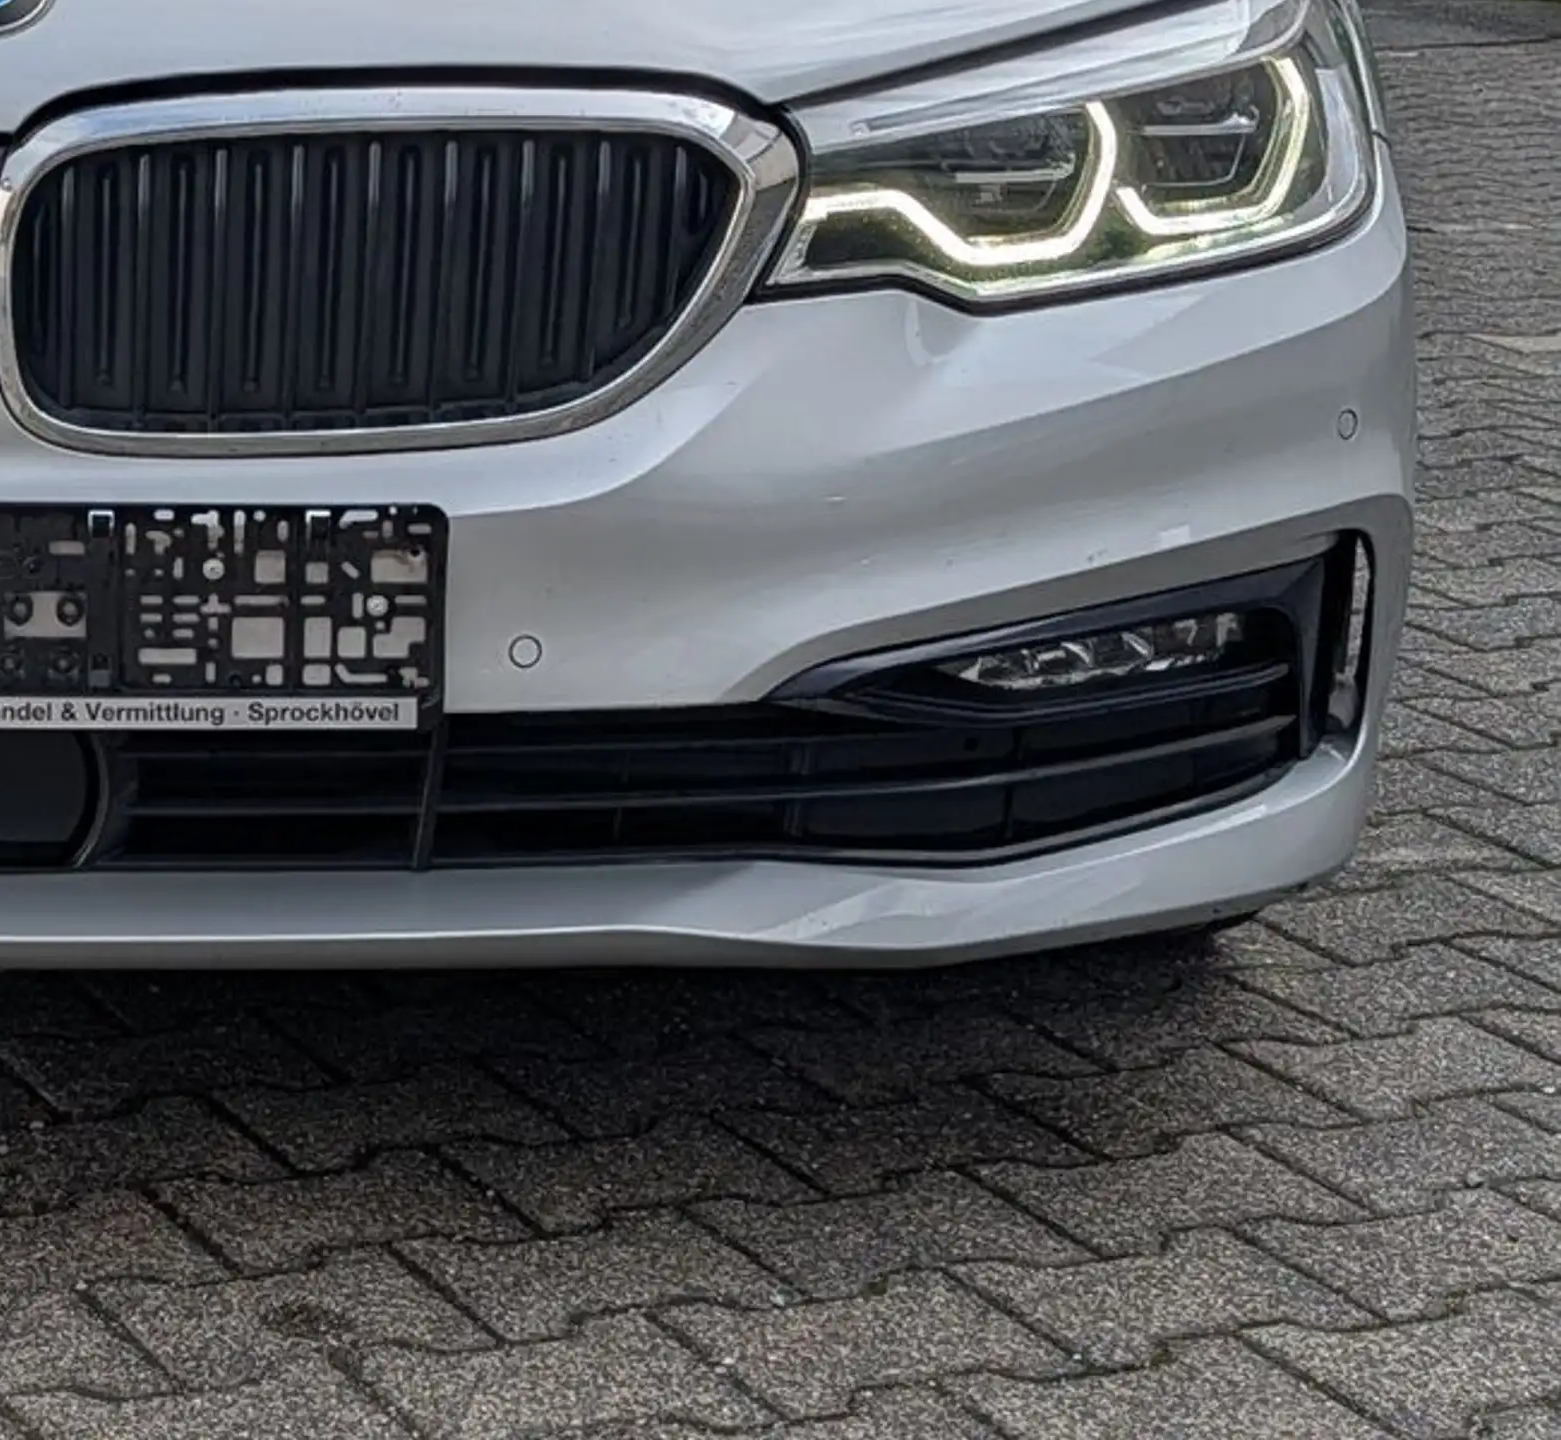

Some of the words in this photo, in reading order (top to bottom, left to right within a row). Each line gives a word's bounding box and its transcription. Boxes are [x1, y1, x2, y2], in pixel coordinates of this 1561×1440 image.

[61, 702, 78, 722] &
[85, 702, 225, 726] Vermittlung
[247, 702, 399, 726] Sprockhövel
